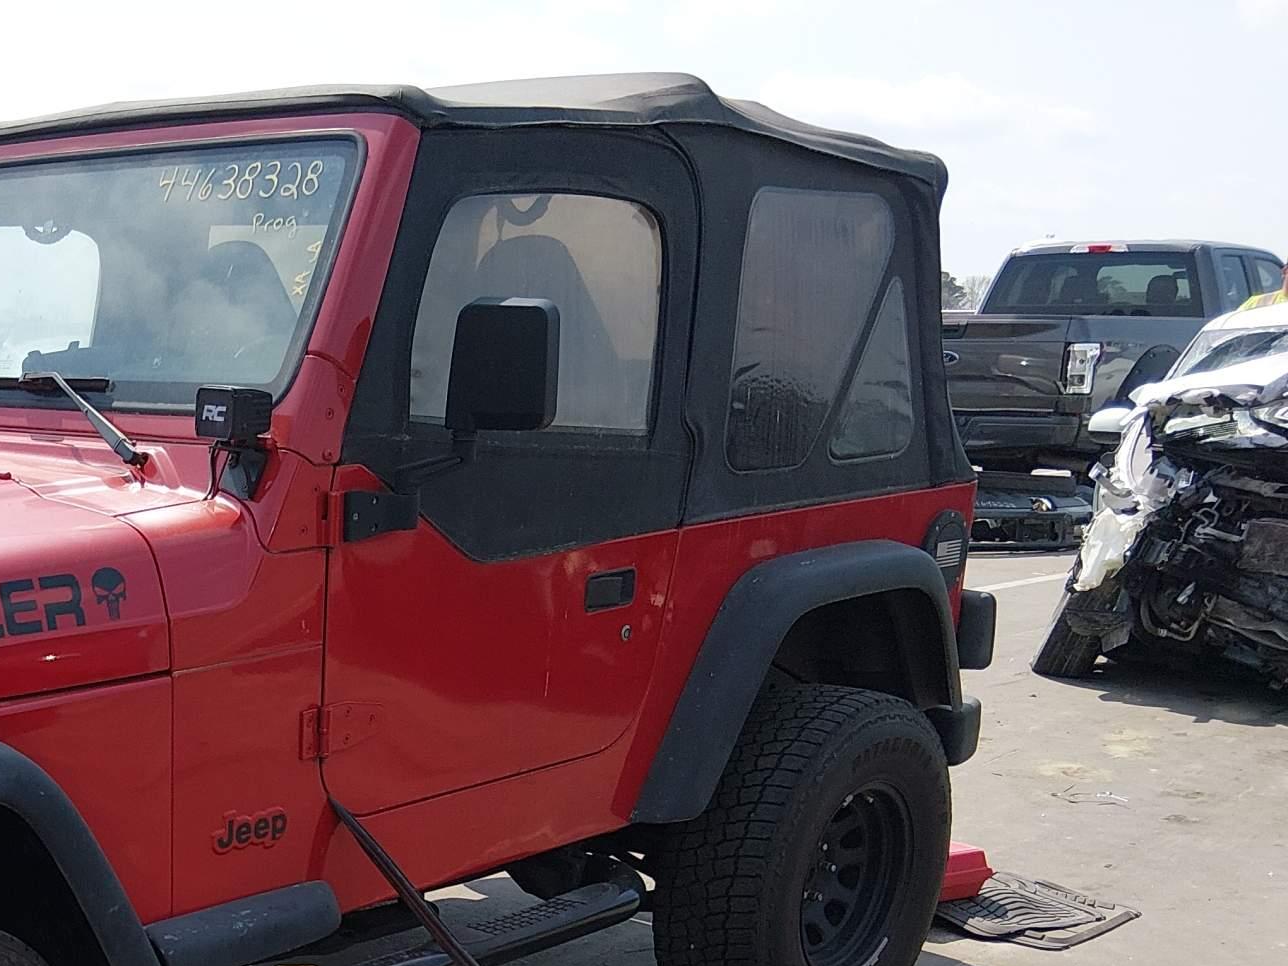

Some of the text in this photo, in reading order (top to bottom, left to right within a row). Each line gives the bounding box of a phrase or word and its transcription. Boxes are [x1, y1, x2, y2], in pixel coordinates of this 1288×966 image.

[159, 160, 324, 202] 44638328
[252, 213, 298, 238] Prog
[201, 404, 228, 422] RC
[216, 813, 289, 849] Jeep
